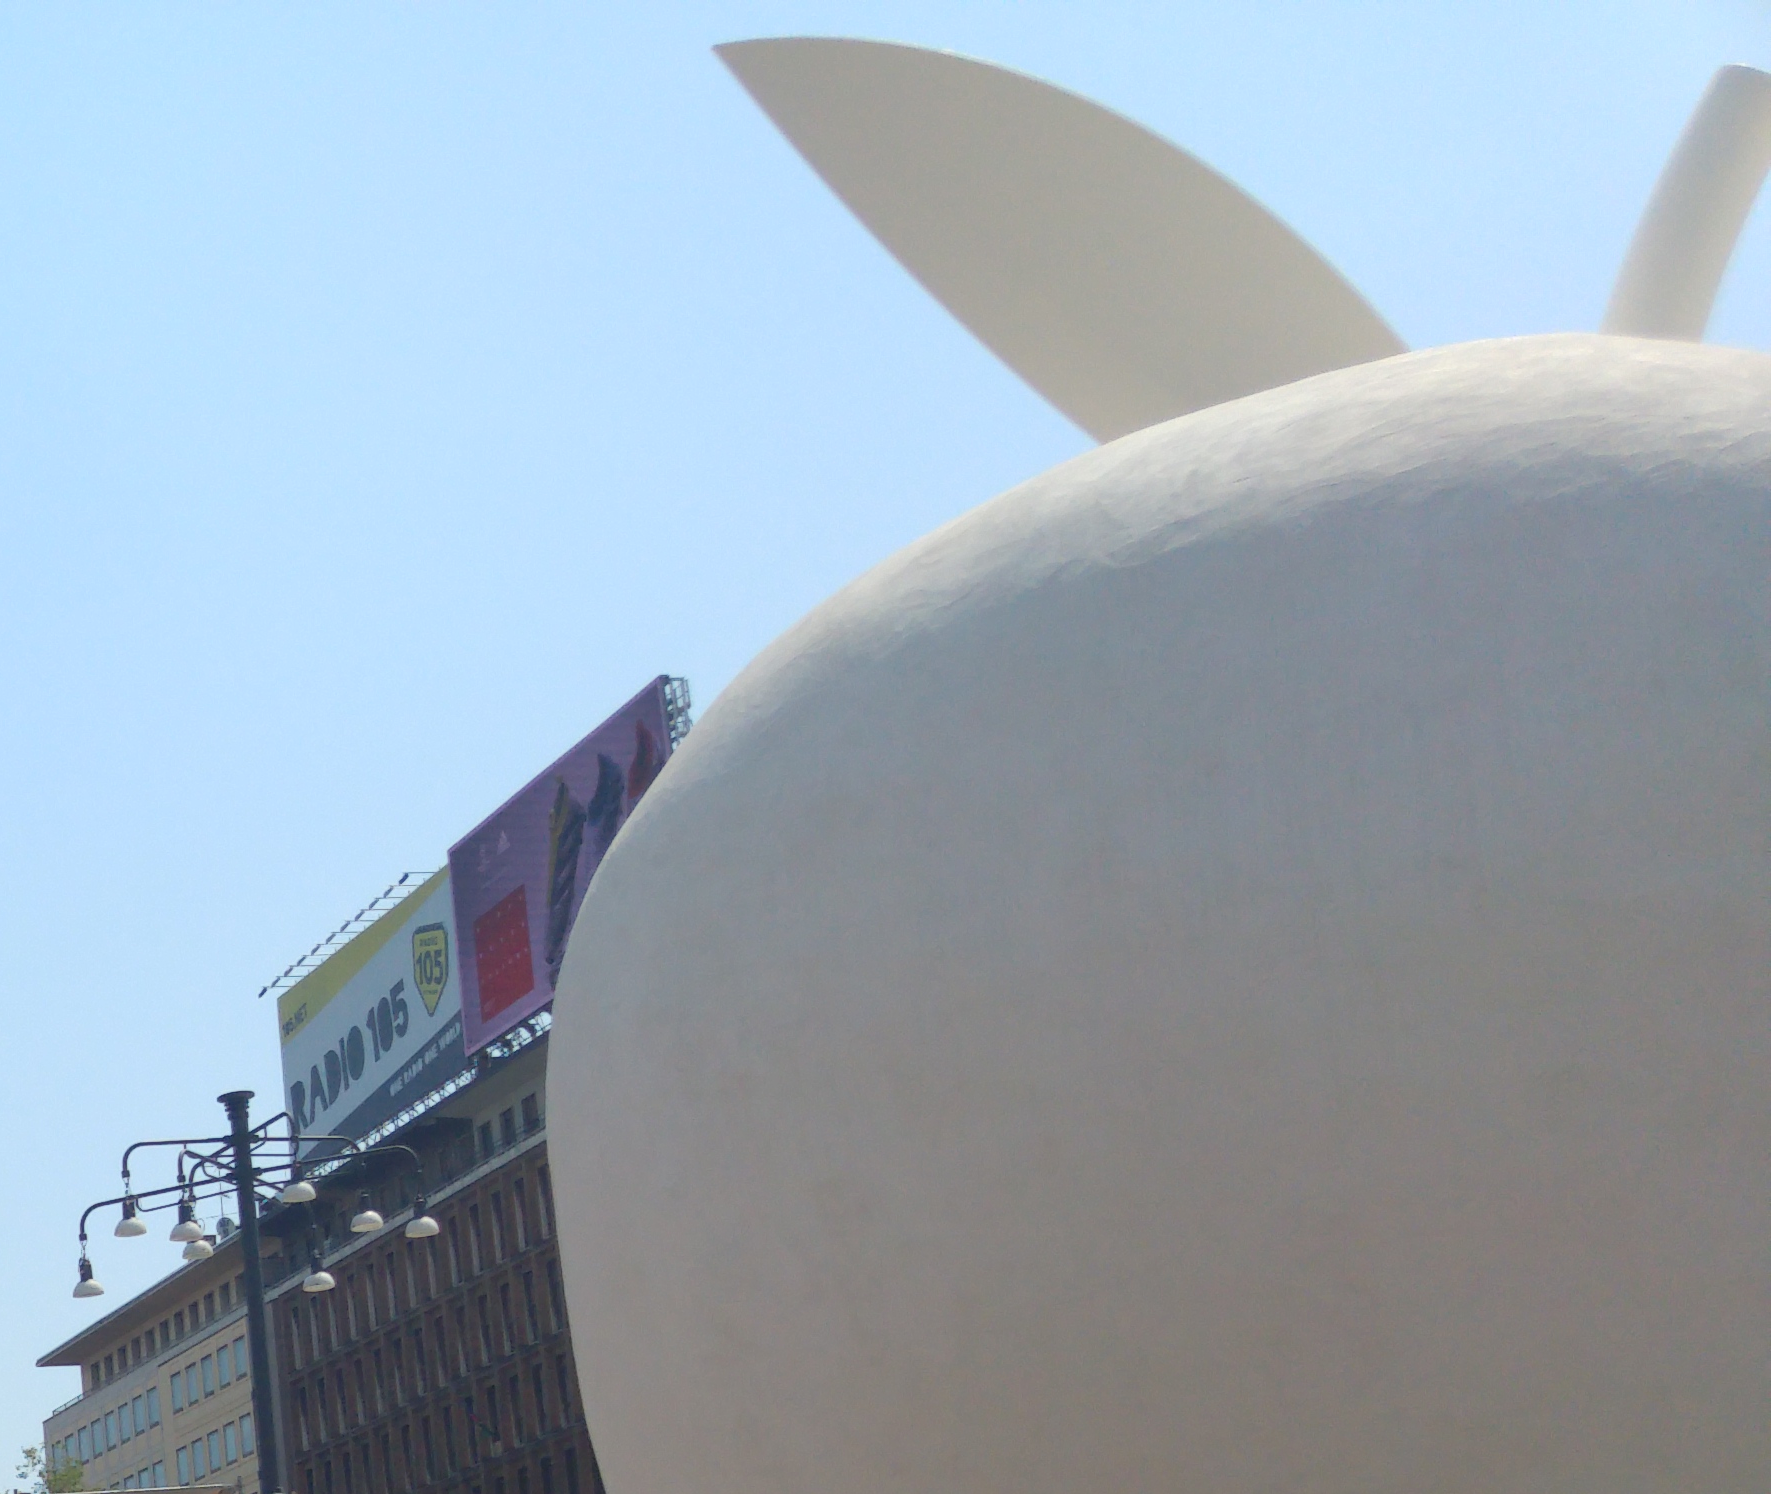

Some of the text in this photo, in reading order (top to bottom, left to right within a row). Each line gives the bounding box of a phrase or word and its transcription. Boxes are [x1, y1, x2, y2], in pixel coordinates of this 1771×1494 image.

[416, 949, 444, 985] 105
[290, 978, 409, 1134] RADIO 105
